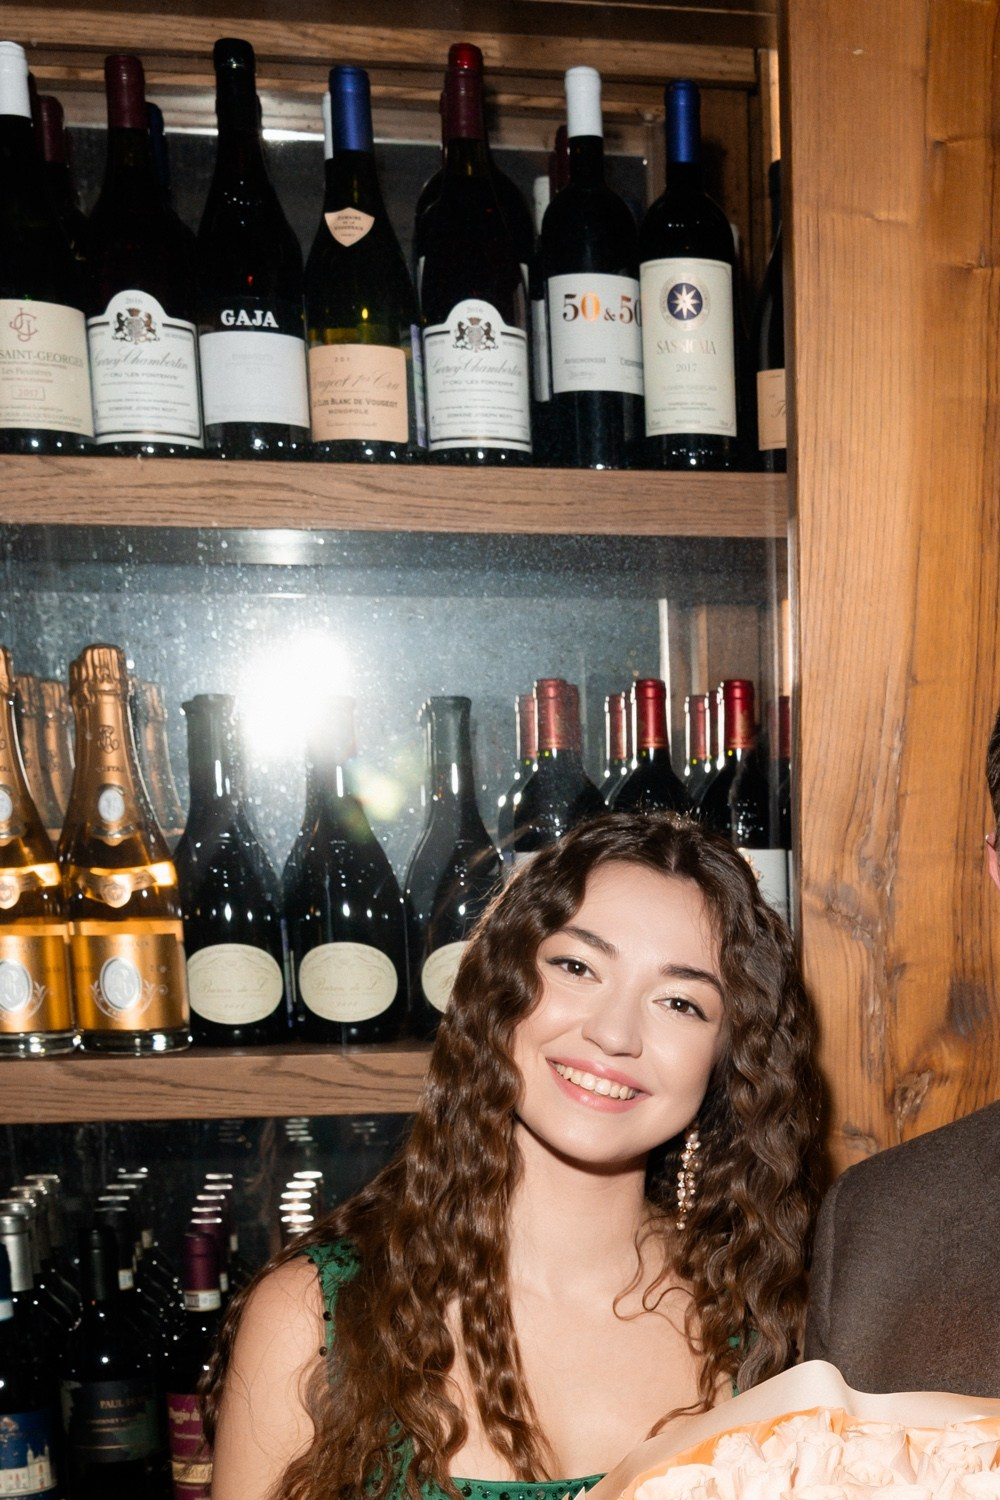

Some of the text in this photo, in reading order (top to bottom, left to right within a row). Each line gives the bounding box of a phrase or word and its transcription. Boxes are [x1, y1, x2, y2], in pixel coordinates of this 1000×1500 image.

[562, 291, 601, 322] 50
[603, 307, 616, 322] &
[220, 309, 279, 328] GAJA
[675, 363, 698, 373] 2017
[100, 1399, 125, 1409] PAUL
